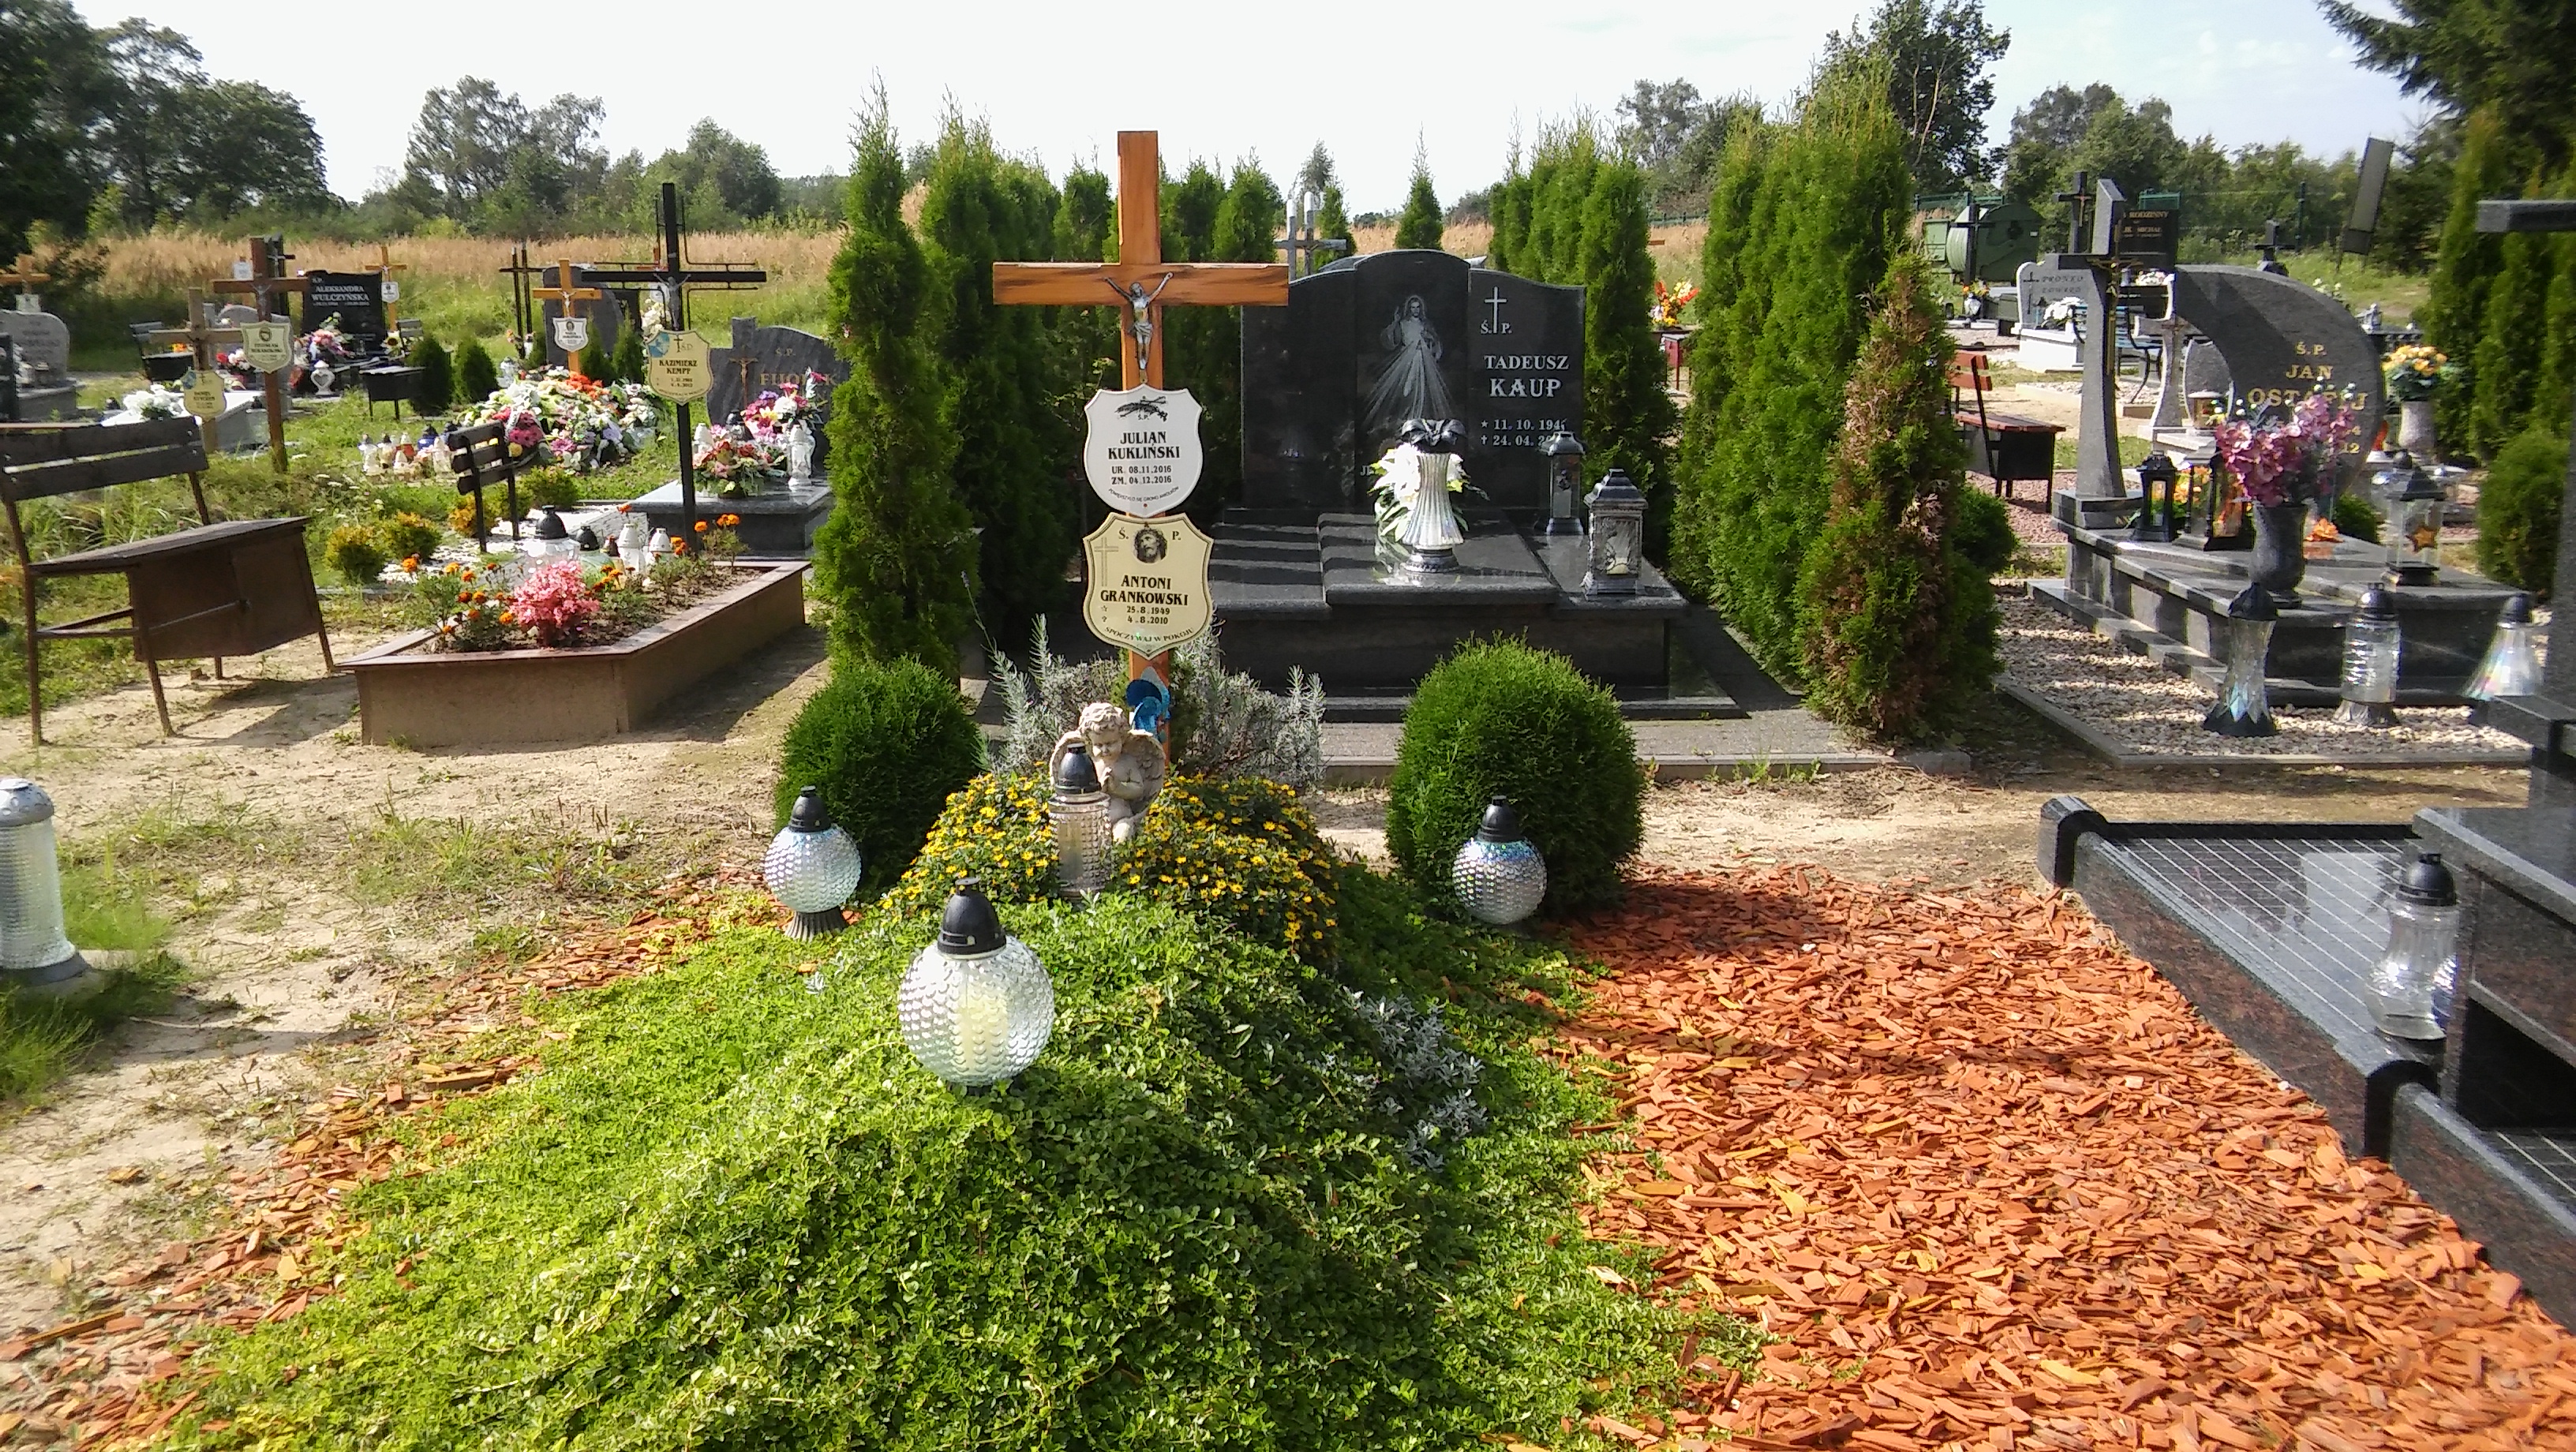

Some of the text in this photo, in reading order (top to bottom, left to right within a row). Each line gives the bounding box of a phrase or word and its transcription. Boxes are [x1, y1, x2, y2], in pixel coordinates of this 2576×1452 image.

[1484, 355, 1570, 370] TADEUSZ
[2286, 365, 2334, 380] JAN
[1490, 378, 1562, 398] KAUP
[1494, 419, 1513, 430] 11.
[1516, 419, 1535, 430] 10.
[1120, 432, 1166, 444] JULIAN
[1493, 435, 1511, 446] 24.
[1515, 435, 1534, 446] 04.
[1108, 443, 1180, 459] KUKLIŃSKI
[1121, 575, 1171, 589] ANTONI
[1100, 589, 1189, 606] GRANKOWSKI
[1105, 627, 1151, 642] SPOCZYWAJ
